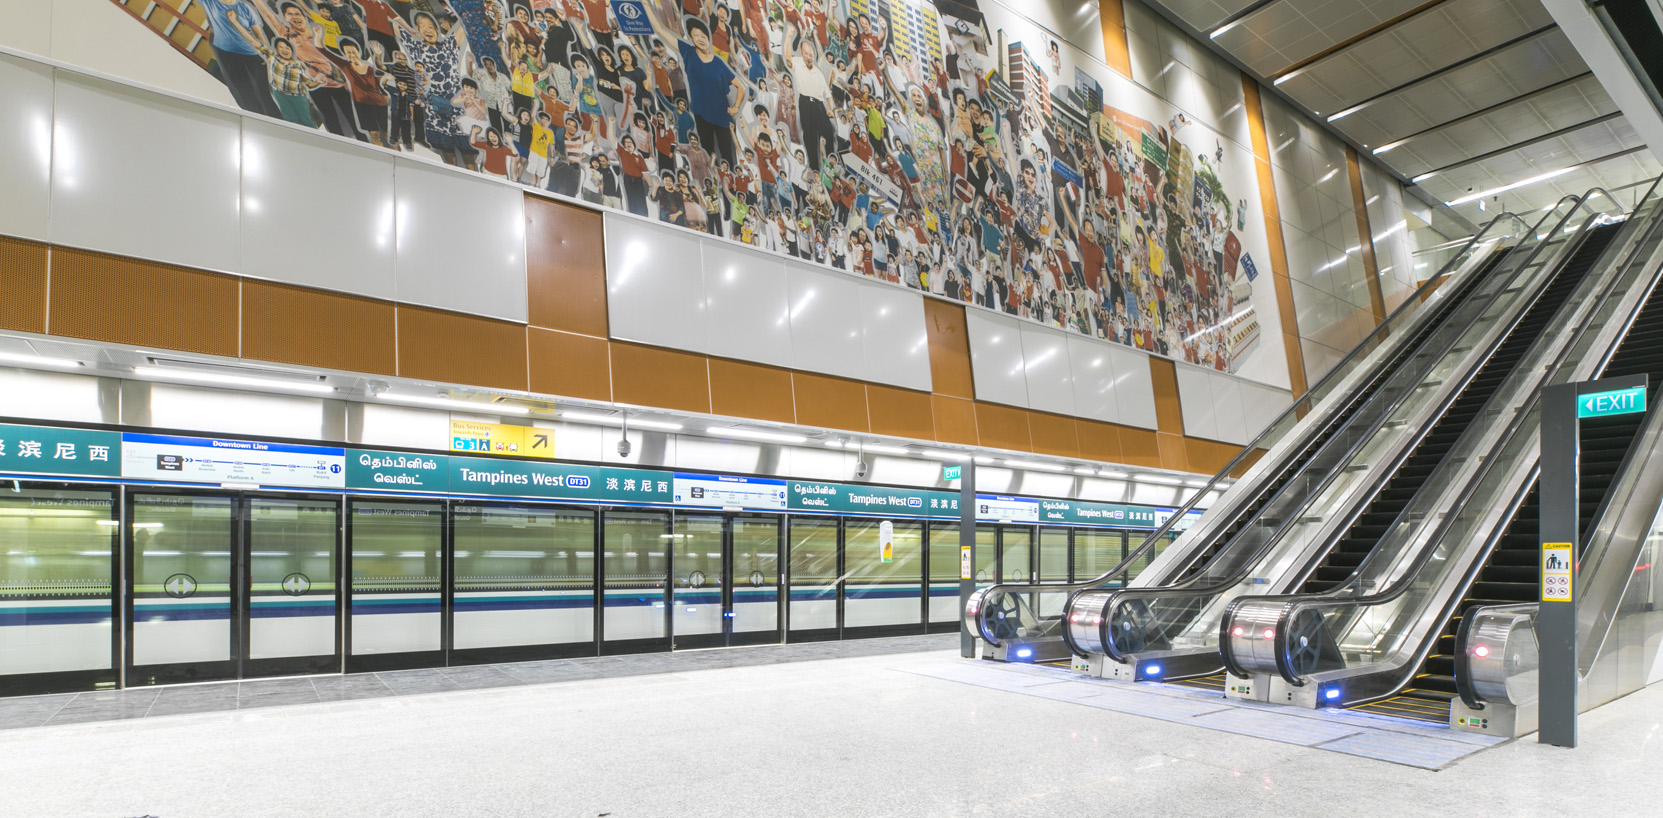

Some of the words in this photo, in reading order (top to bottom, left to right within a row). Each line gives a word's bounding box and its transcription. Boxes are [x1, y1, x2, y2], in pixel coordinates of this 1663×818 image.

[860, 164, 870, 176] Blk
[1597, 392, 1638, 412] EXIT
[466, 423, 491, 432] Services
[0, 439, 110, 462] 滨尼西
[212, 440, 251, 449] Downtown
[480, 442, 488, 451] A
[374, 472, 423, 485] வெஸ்ட்
[460, 468, 528, 486] Tampines
[532, 472, 564, 487] West
[569, 478, 588, 486] DT31
[946, 468, 958, 478] EXIT
[606, 477, 668, 493] 淡滨尼西
[848, 493, 887, 506] Tampines
[888, 496, 907, 506] West
[1076, 508, 1101, 518] Tampines
[1102, 510, 1114, 518] West
